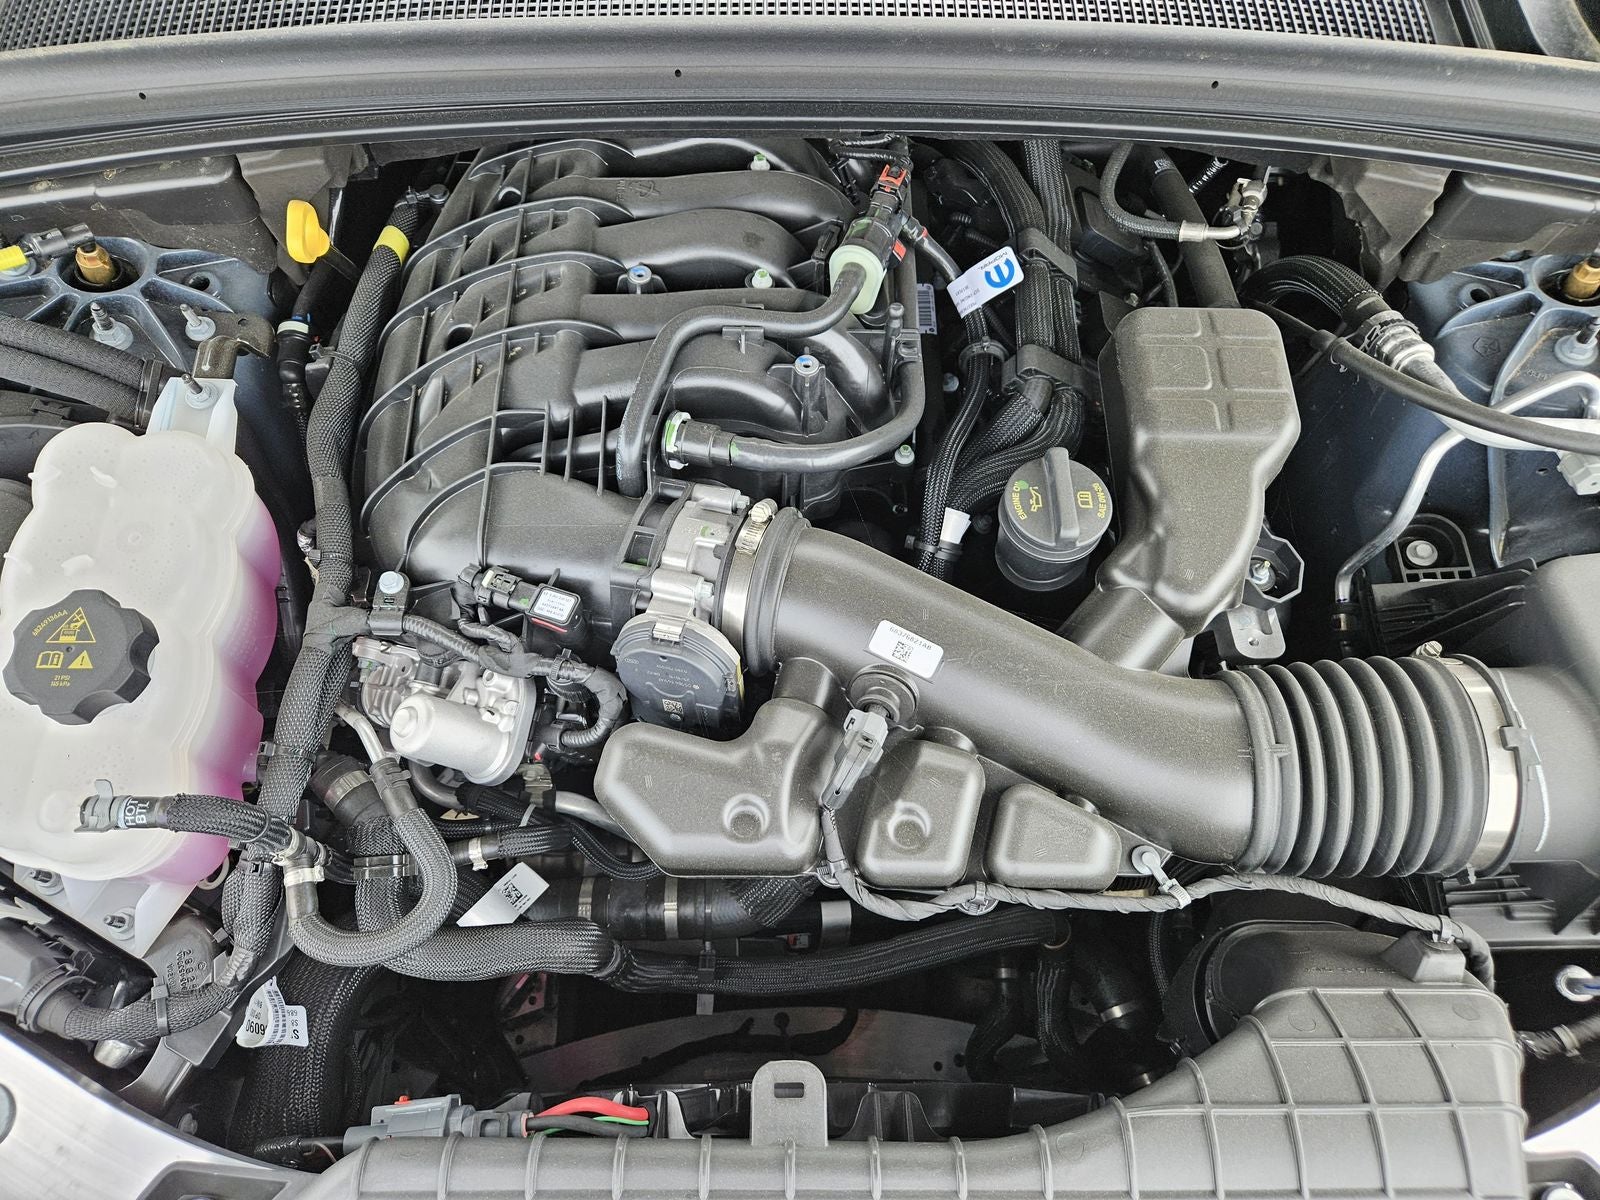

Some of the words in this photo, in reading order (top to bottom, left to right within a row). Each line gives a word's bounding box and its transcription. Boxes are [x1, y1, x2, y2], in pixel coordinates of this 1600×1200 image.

[1012, 492, 1028, 520] ENGINE
[1097, 503, 1107, 519] SAE
[125, 799, 138, 826] HOT
[136, 800, 149, 825] BTL
[246, 1019, 268, 1036] 6090
